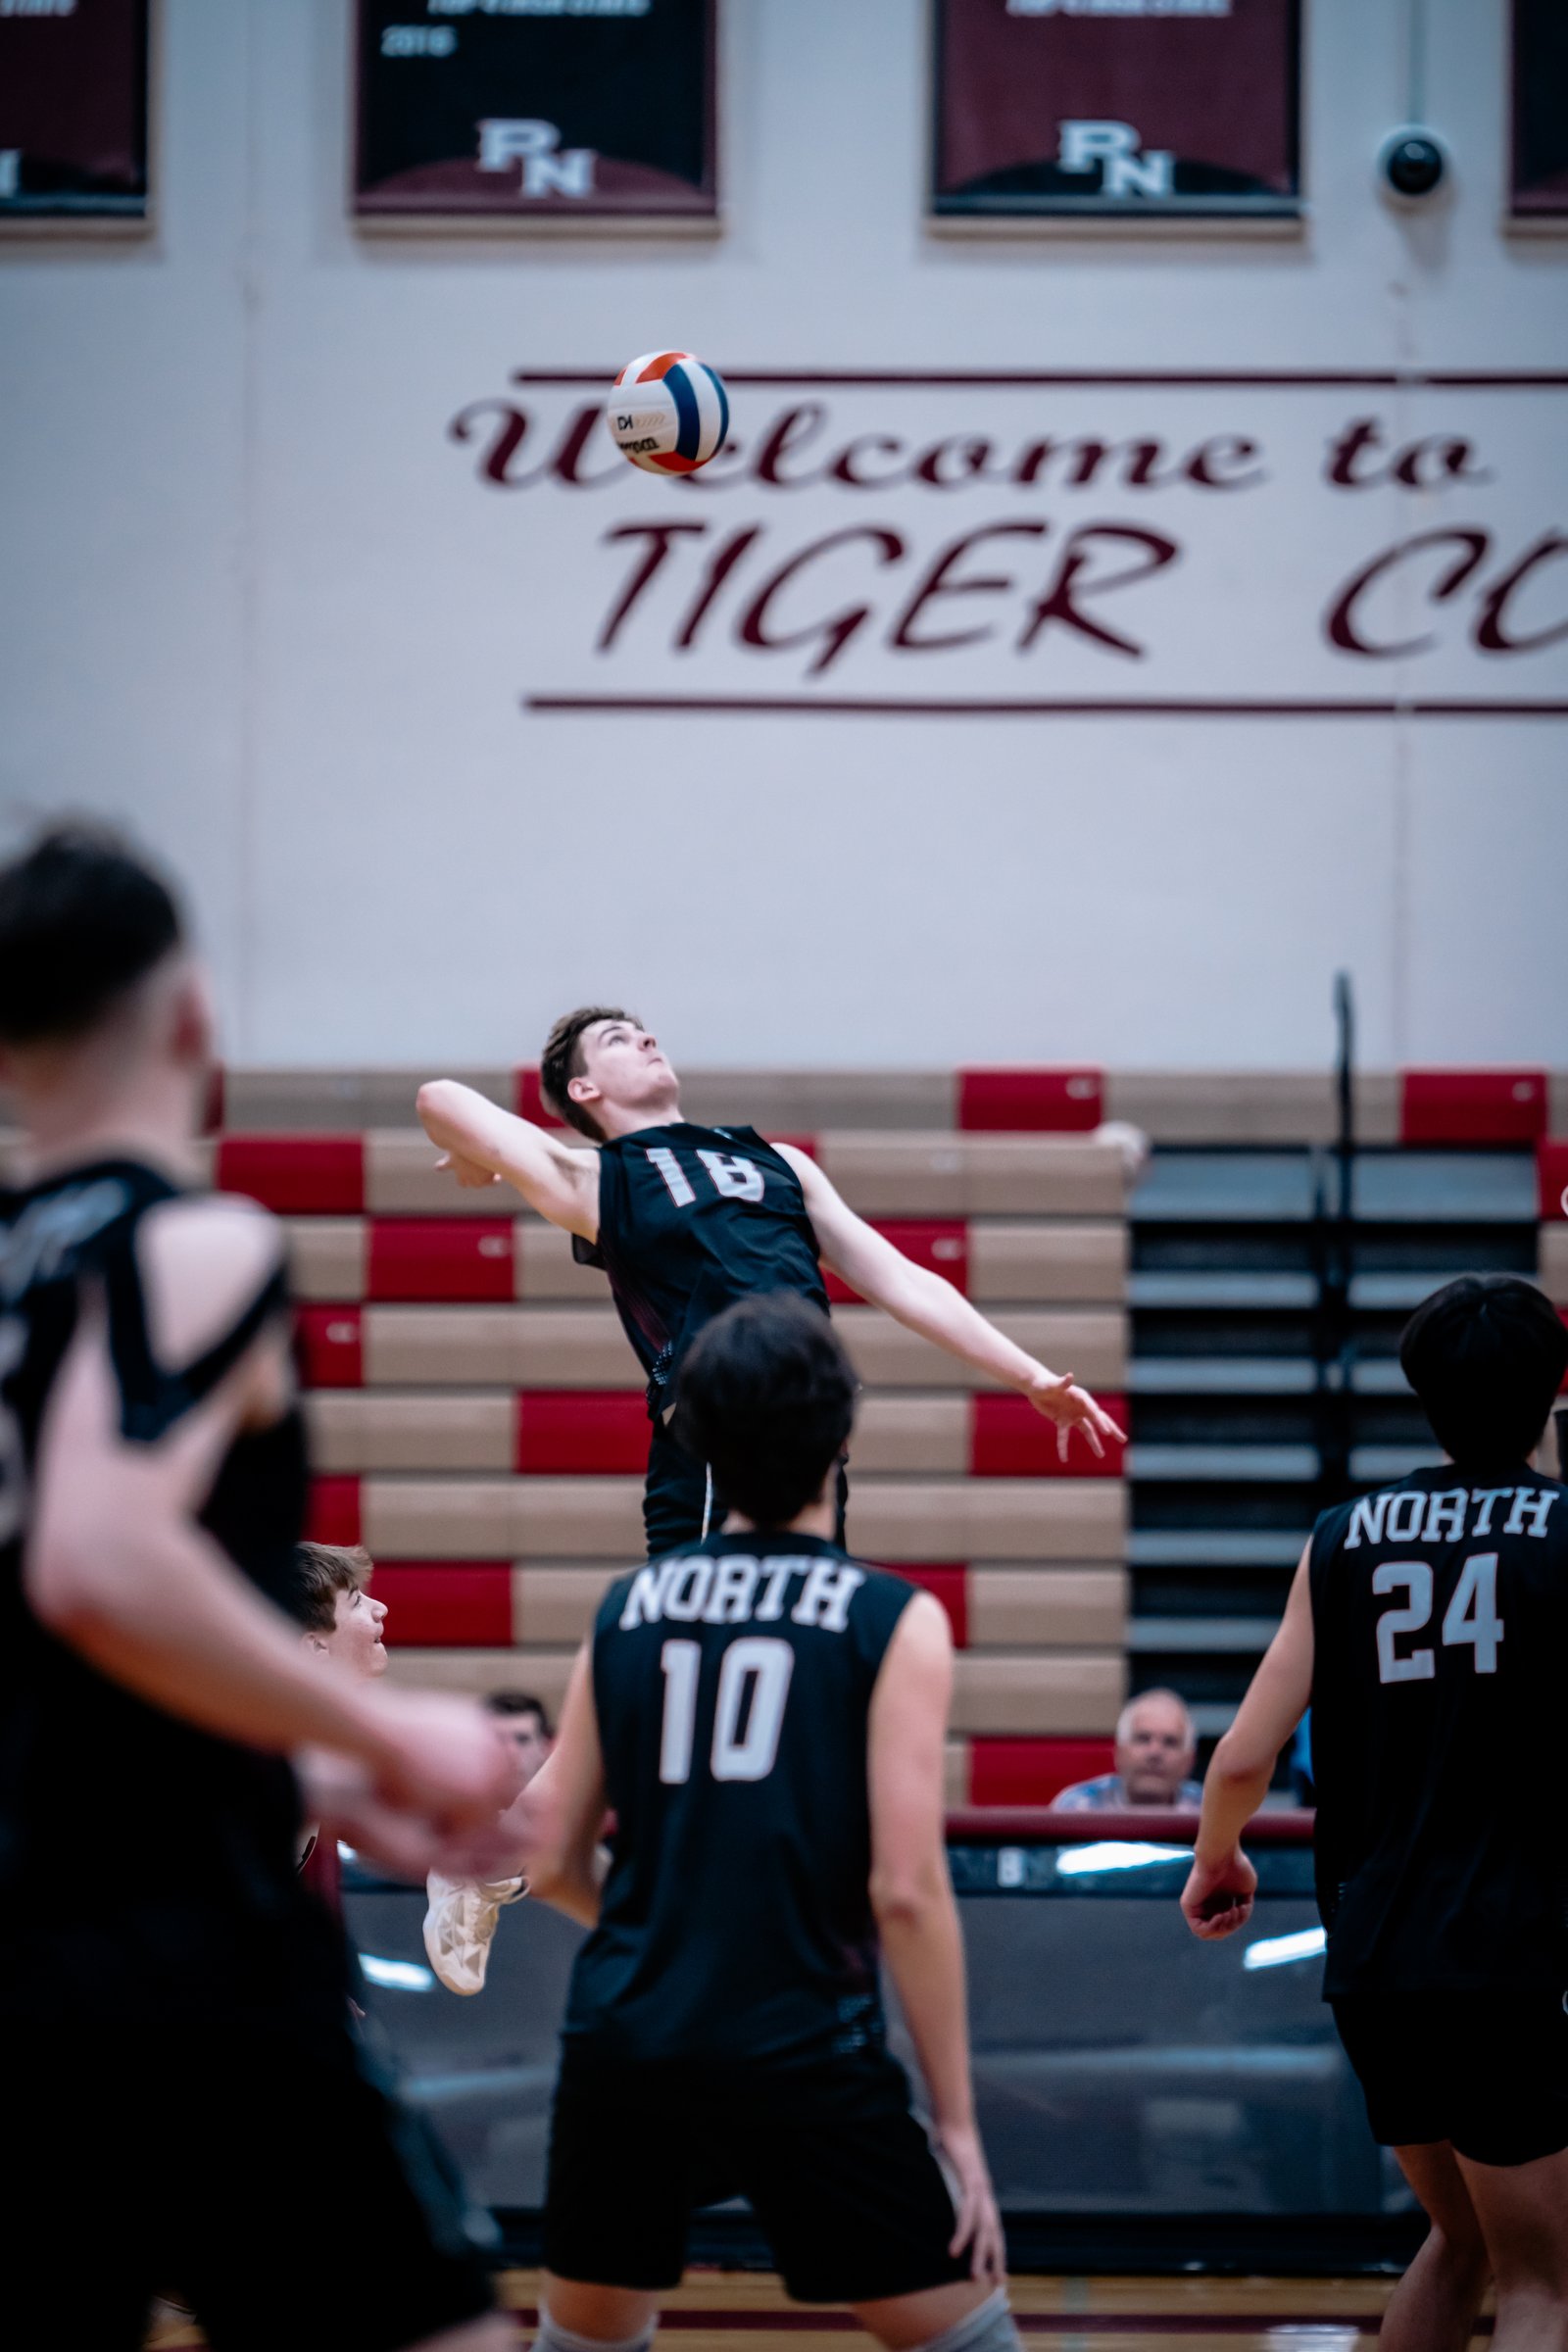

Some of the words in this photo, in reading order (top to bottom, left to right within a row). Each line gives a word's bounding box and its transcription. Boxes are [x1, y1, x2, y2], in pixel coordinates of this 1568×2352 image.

[1322, 416, 1492, 488] to
[600, 519, 1182, 676] TIGER
[1344, 1486, 1560, 1550] NORTH
[618, 1553, 866, 1634] NORTH
[1372, 1551, 1504, 1685] 24
[659, 1636, 795, 1786] 10
